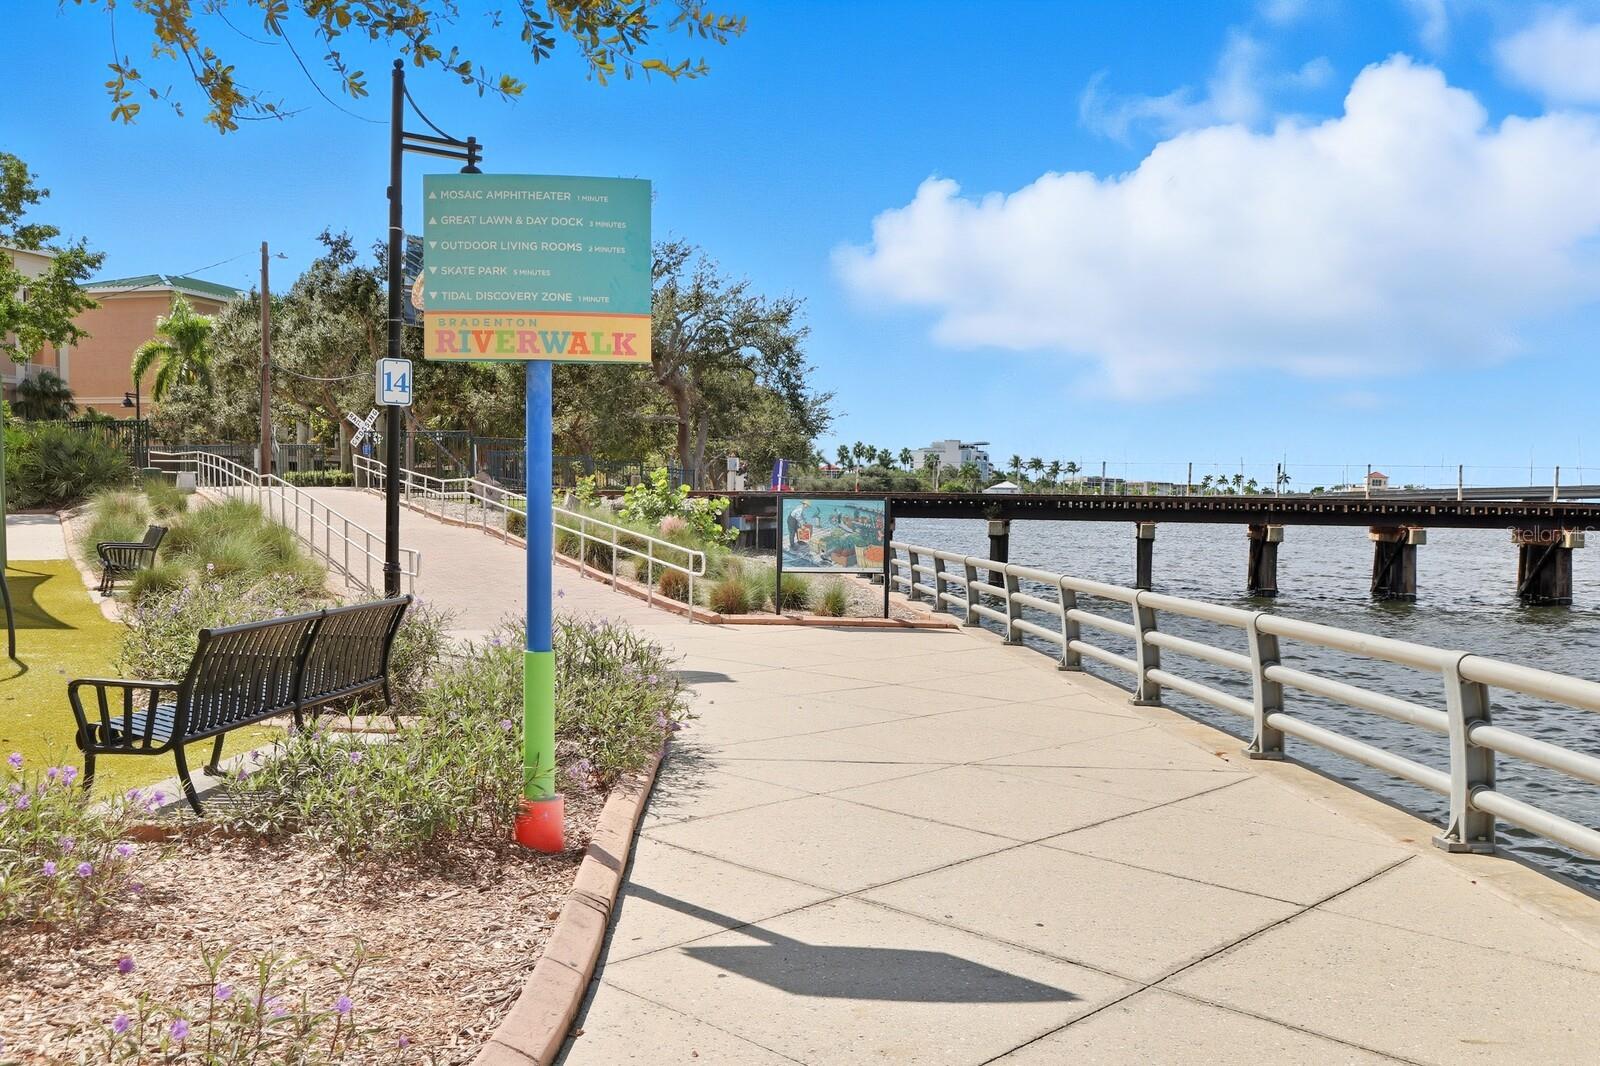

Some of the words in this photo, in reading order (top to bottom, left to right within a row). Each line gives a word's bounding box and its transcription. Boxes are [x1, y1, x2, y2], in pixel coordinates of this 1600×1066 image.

[440, 191, 483, 199] MOSAIC
[486, 191, 571, 201] AMPHITHEATER
[582, 195, 609, 203] MINUTE
[441, 216, 476, 225] GREAT
[480, 216, 512, 225] LAWN
[516, 217, 523, 225] &
[526, 217, 548, 225] DAY
[551, 218, 583, 226] DOCK
[595, 221, 627, 229] MINUTES
[441, 241, 496, 250] OUTDOOR
[501, 242, 538, 251] LIVING
[541, 242, 582, 252] ROOMS
[441, 266, 475, 275] SKATE
[478, 267, 508, 275] PARK
[441, 292, 473, 300] TIDAL
[476, 292, 538, 301] DISCOVERY
[542, 293, 573, 302] ZONE
[438, 318, 538, 327] BRADENTON
[435, 329, 637, 356] RIVERWALK
[384, 370, 410, 392] 14
[351, 409, 379, 446] CROSSING
